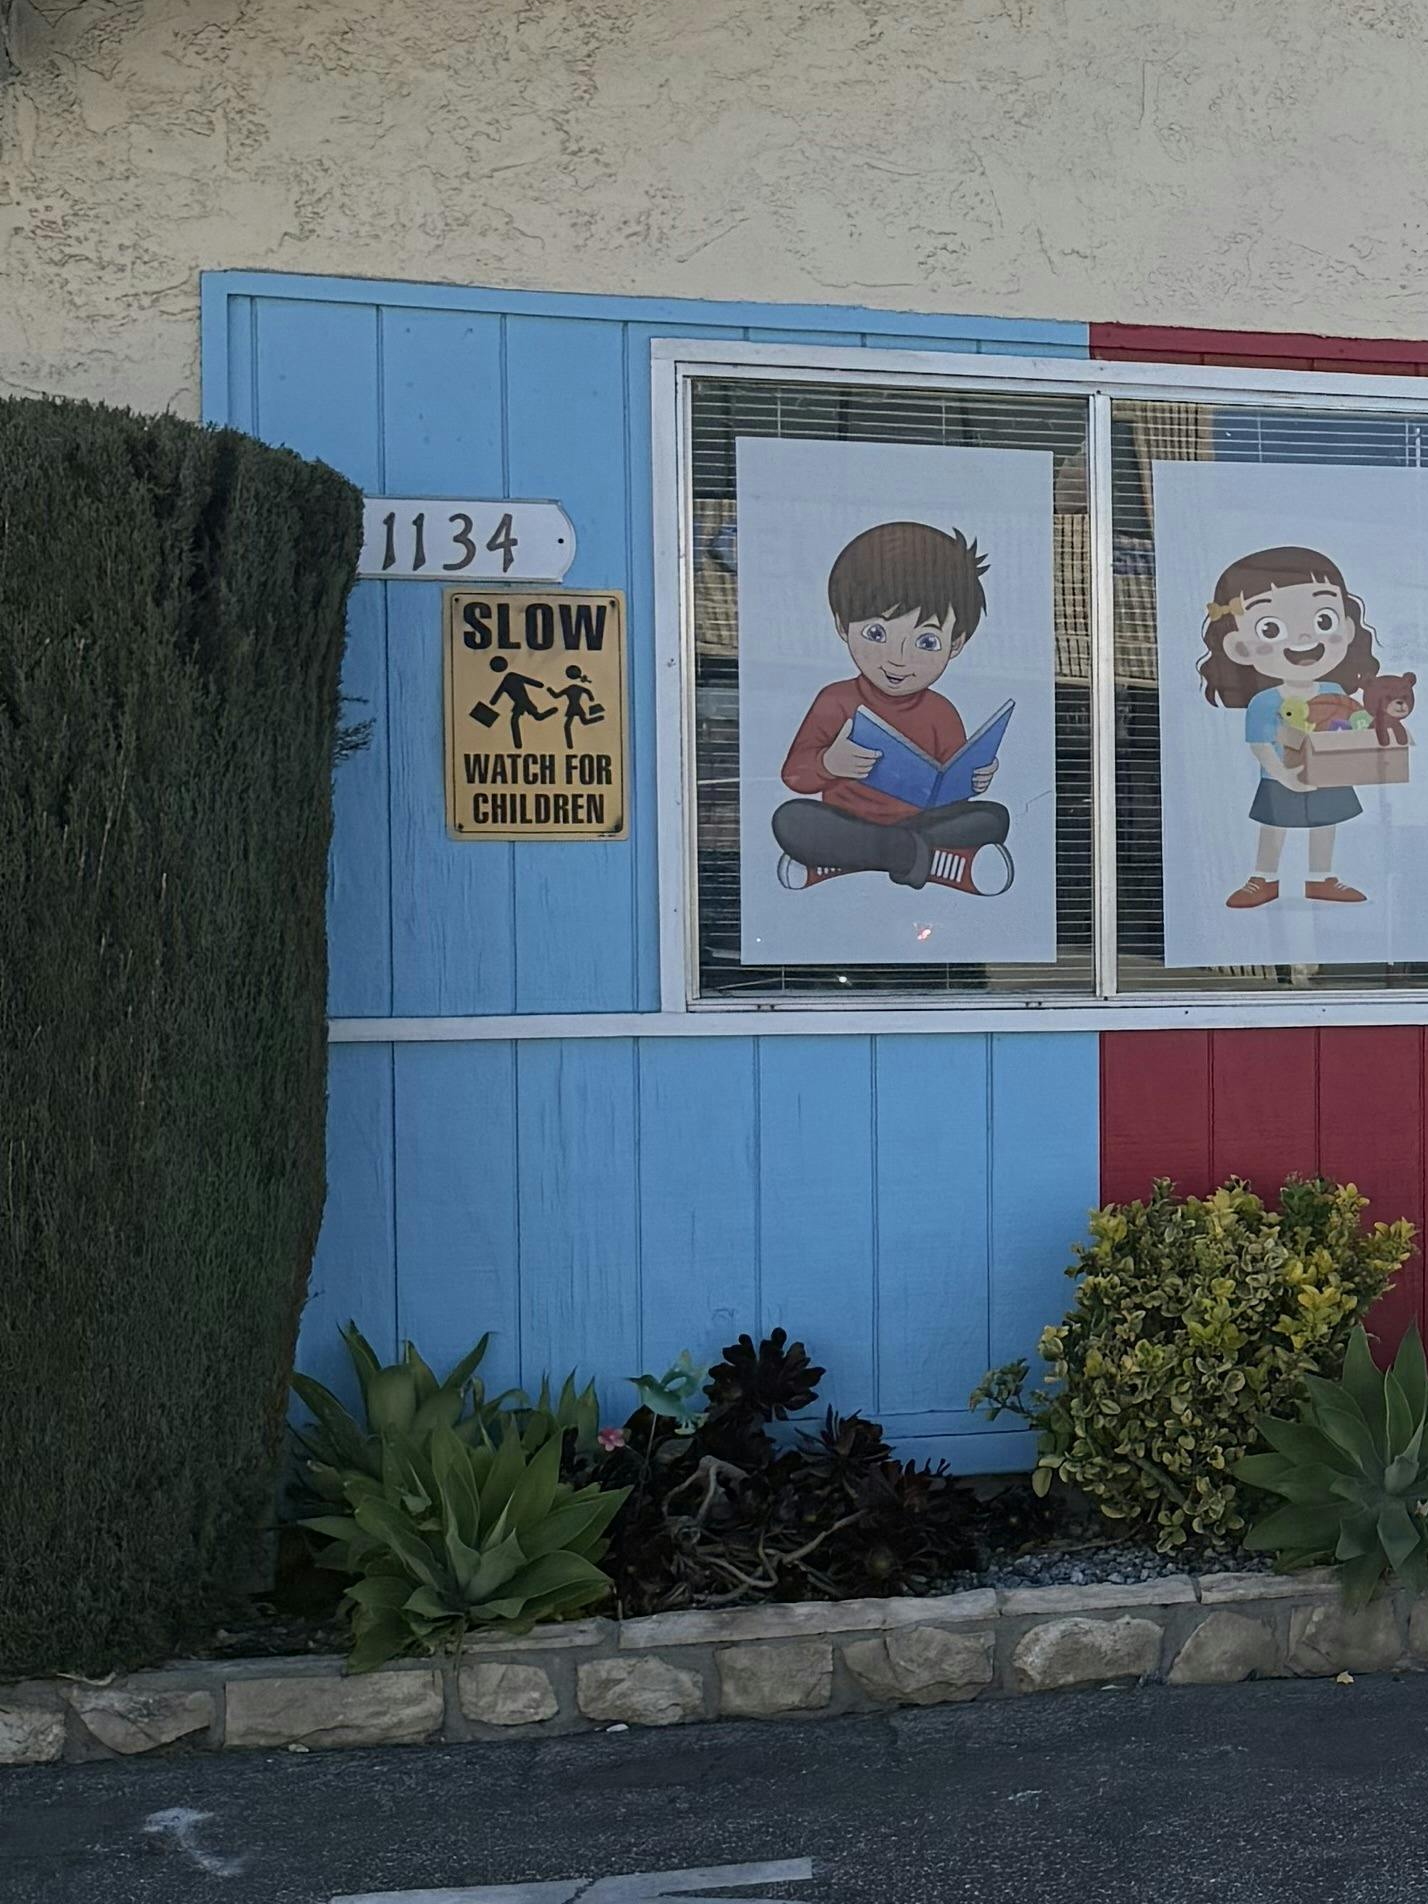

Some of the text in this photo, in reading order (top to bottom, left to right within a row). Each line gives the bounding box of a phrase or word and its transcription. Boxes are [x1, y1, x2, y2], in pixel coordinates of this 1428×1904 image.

[381, 512, 519, 573] 1134
[462, 602, 608, 651] SLOW
[463, 753, 613, 786] WATCH FOR
[472, 792, 605, 825] CHILDREN
